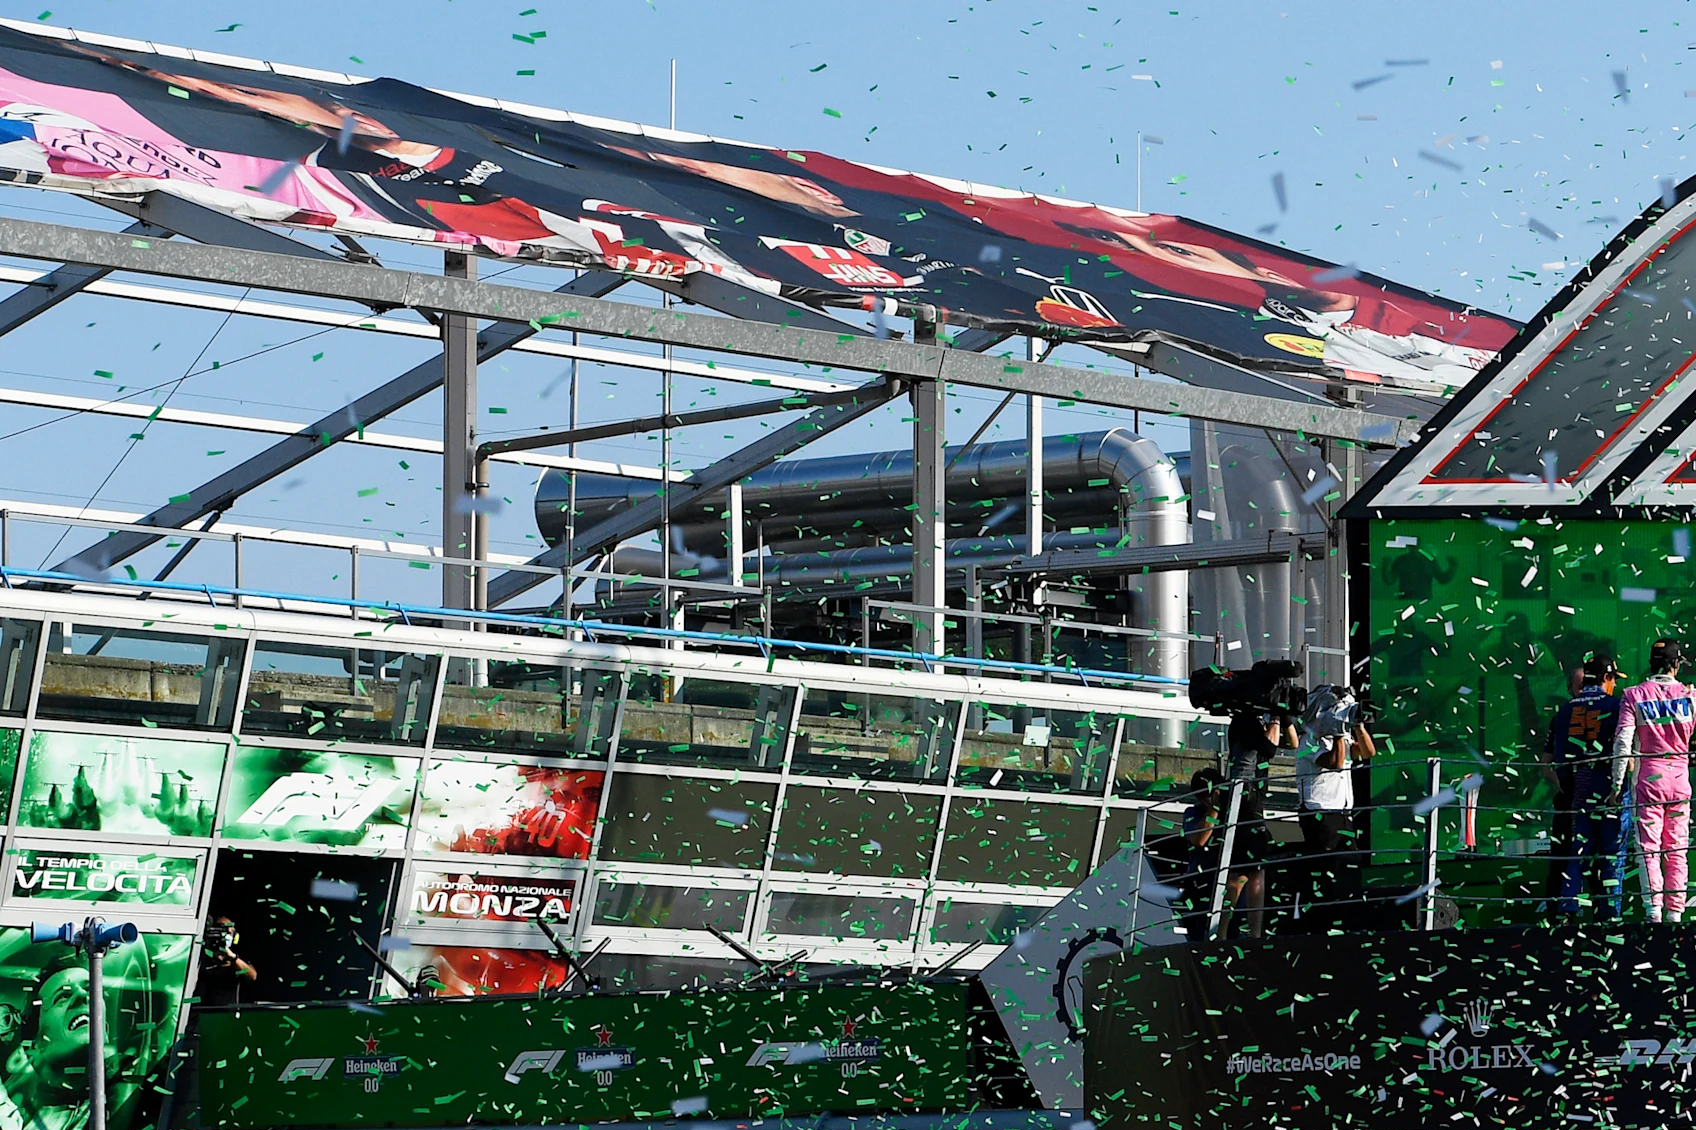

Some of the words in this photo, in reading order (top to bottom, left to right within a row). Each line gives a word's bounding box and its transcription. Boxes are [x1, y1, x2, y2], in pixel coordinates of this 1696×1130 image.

[1569, 706, 1601, 740] 55
[18, 856, 33, 867] IL
[36, 857, 106, 869] TEMPIO
[109, 858, 167, 872] DELLA
[15, 869, 192, 894] VELOCITÀ
[416, 881, 500, 893] AUTODROMO
[500, 885, 572, 896] NAZIONALE
[411, 891, 571, 919] MONZA
[345, 1059, 397, 1075] Heineken
[1226, 1054, 1361, 1076] #WeRaceAsOne
[1427, 1044, 1537, 1072] ROLEX
